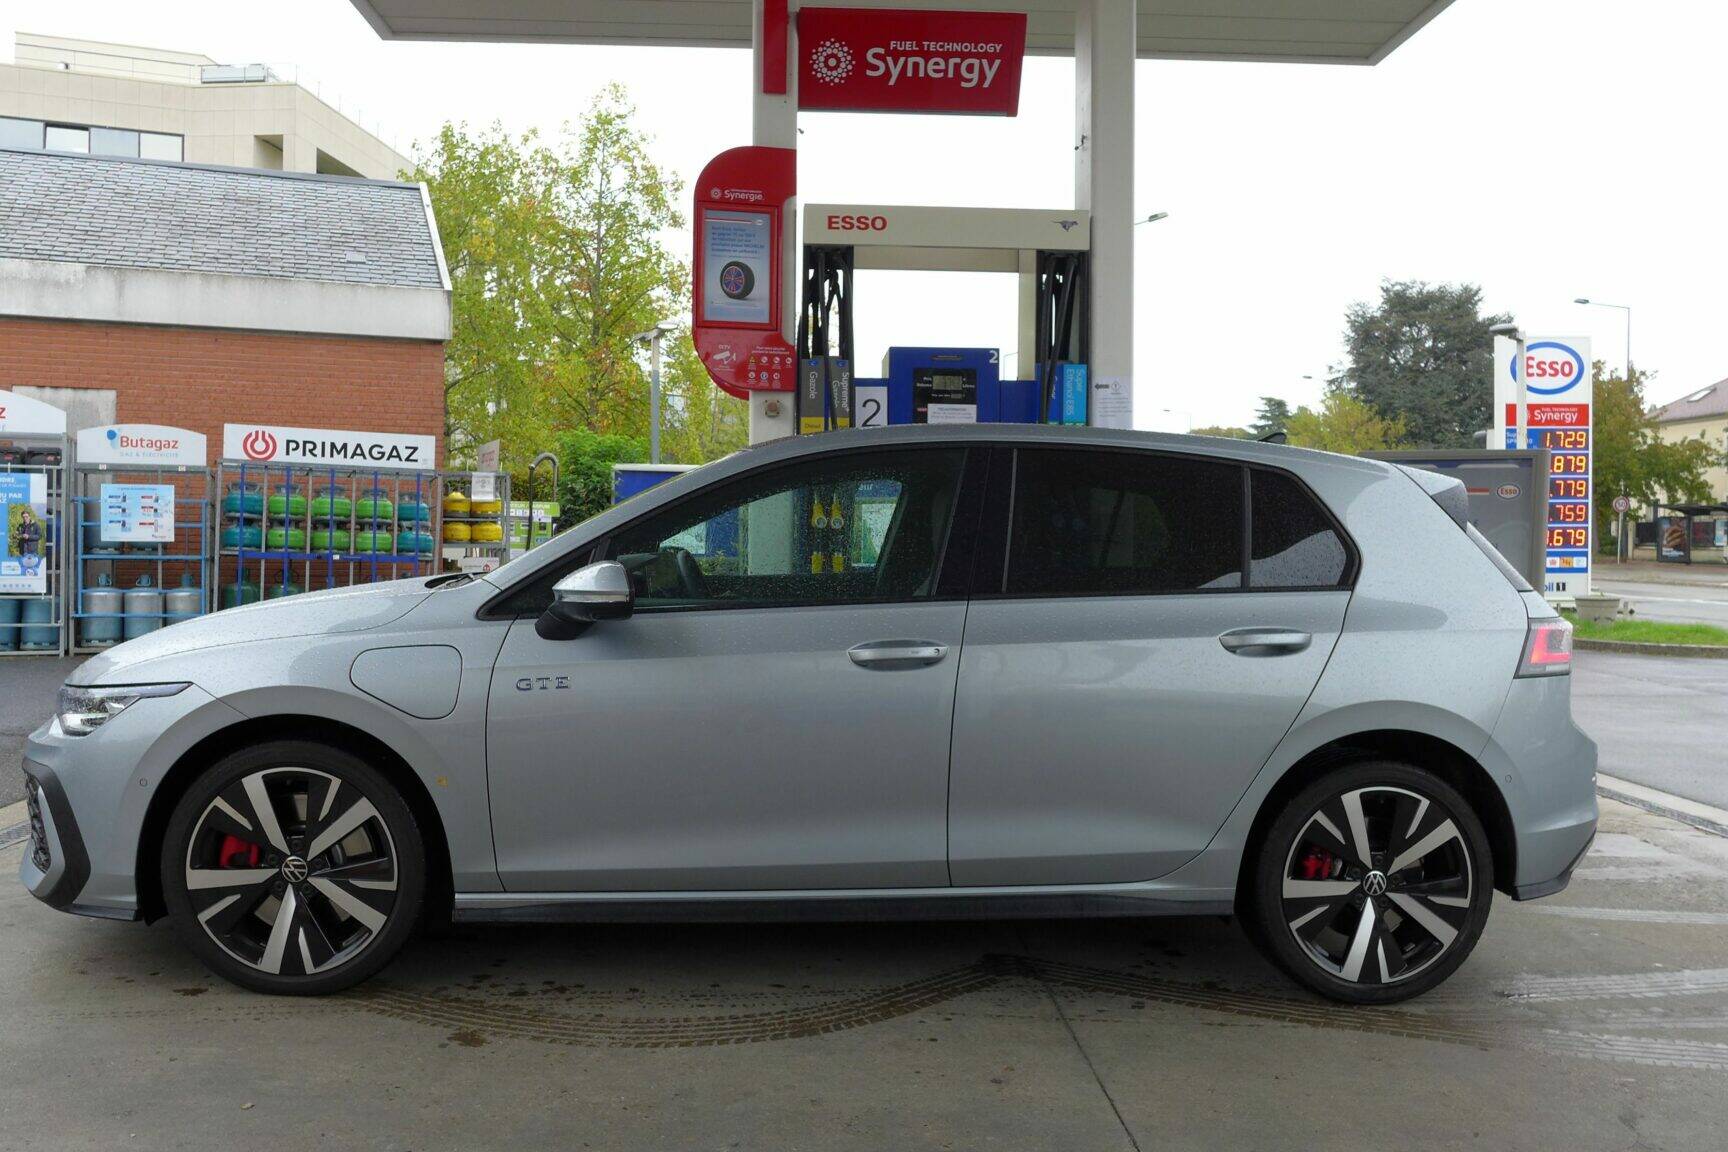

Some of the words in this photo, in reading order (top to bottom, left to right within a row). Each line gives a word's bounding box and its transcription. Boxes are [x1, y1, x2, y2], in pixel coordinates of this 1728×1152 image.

[890, 41, 919, 50] FUEL
[923, 42, 1002, 53] TECHNOLOGY
[866, 47, 1001, 88] Synergy
[724, 189, 763, 201] Synergie
[827, 215, 888, 231] ESSO
[989, 349, 999, 364] 2
[1526, 356, 1574, 378] Esso
[809, 371, 818, 399] Gazole
[862, 398, 881, 427] 2
[1534, 409, 1578, 424] Synergy
[120, 435, 178, 451] Butagaz
[1546, 431, 1587, 448] 1.729
[286, 439, 419, 463] PRIMAGAZ
[1550, 455, 1586, 473] .879
[1549, 480, 1586, 497] .779
[1549, 504, 1586, 522] .759
[516, 676, 569, 691] GTE
